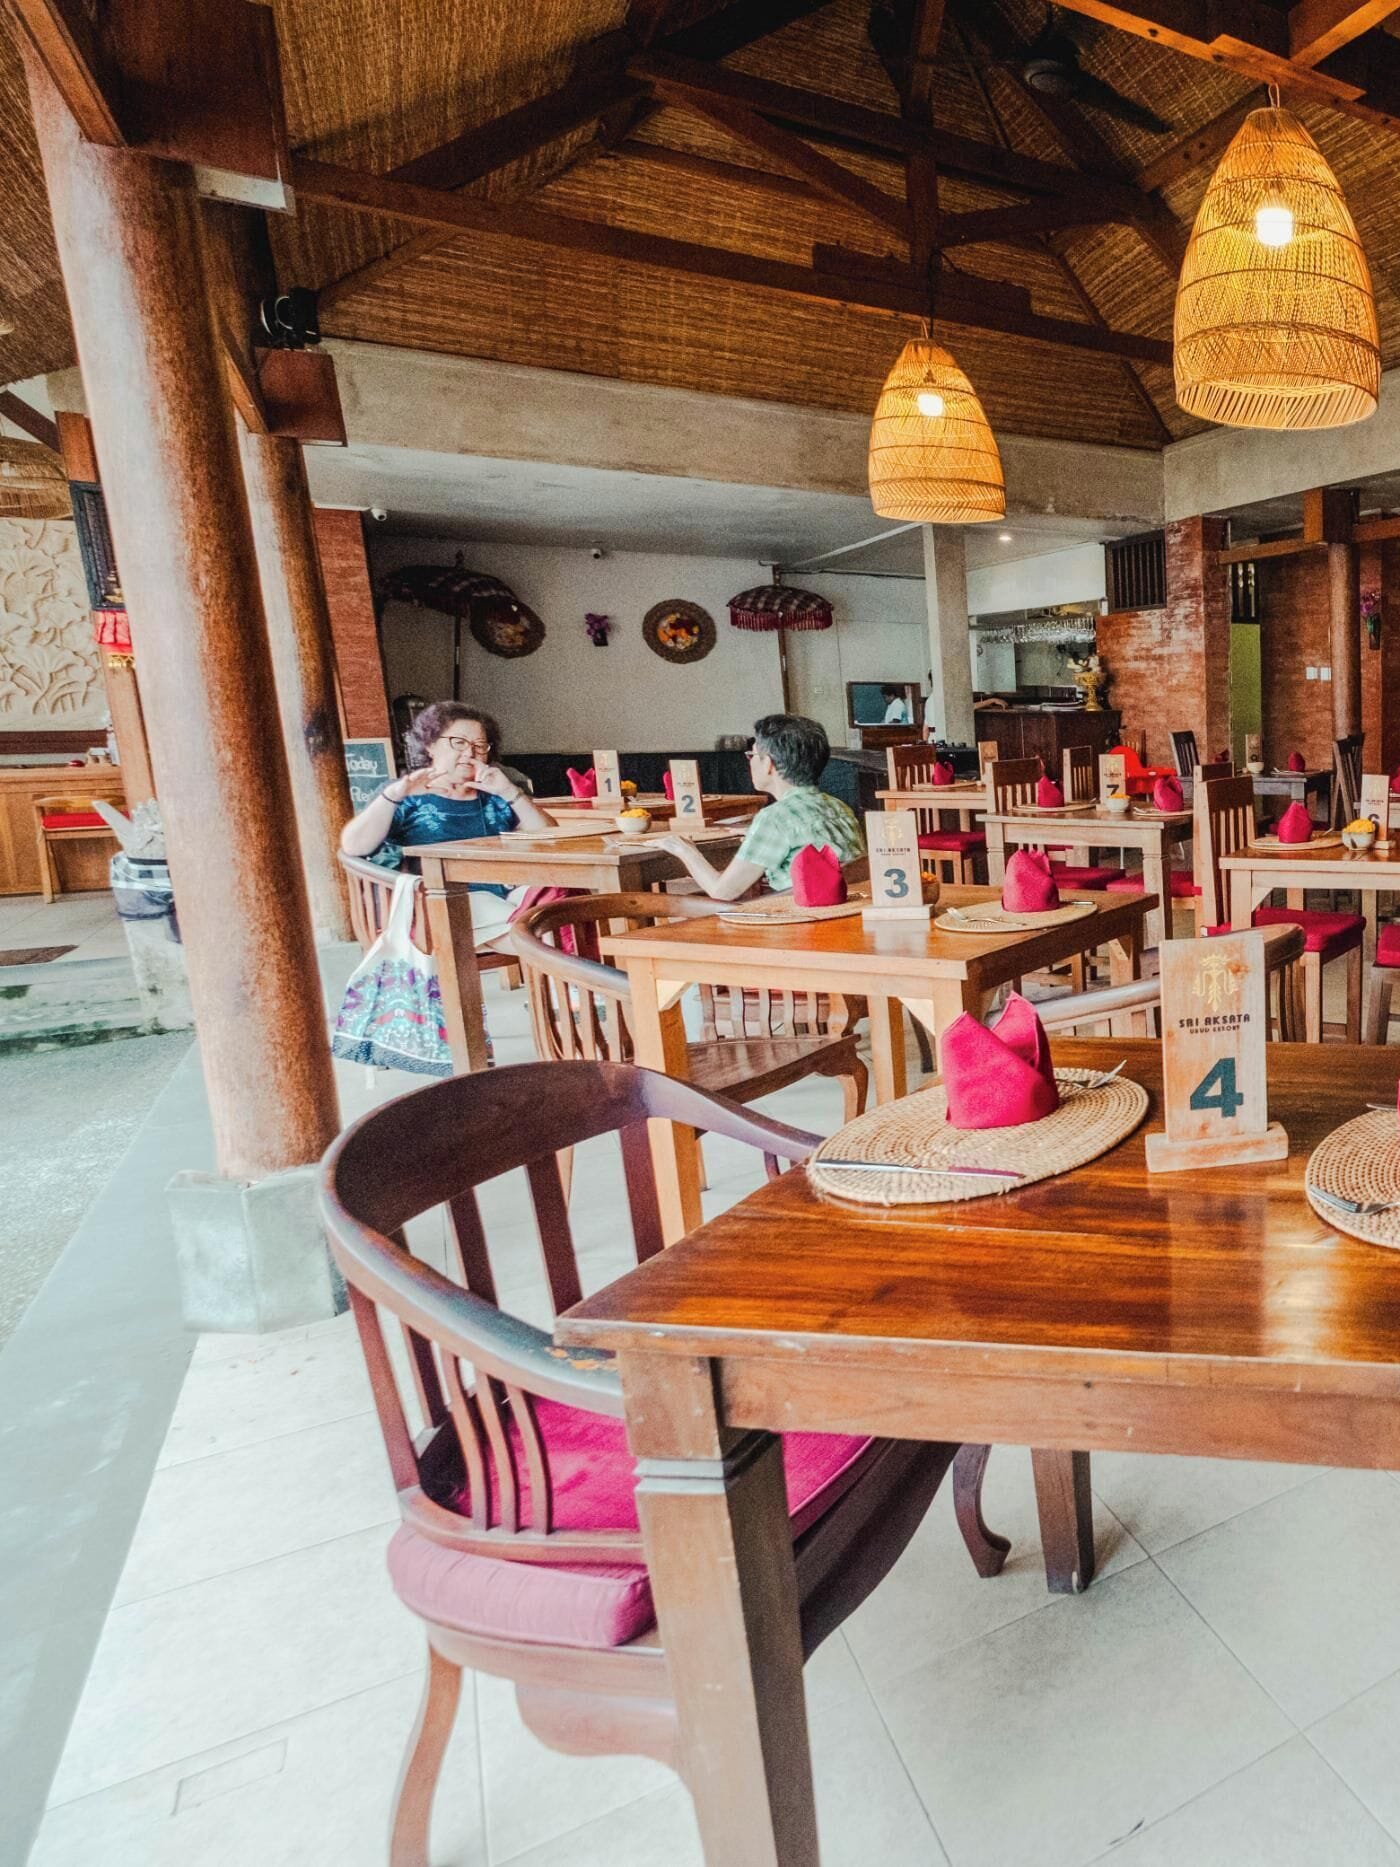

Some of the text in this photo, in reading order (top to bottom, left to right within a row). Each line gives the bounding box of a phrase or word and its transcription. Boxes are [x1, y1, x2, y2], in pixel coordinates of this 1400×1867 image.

[604, 778, 612, 792] 1
[681, 794, 696, 813] 2
[883, 868, 909, 898] 3
[1178, 1013, 1251, 1028] SRI AKSATA
[1189, 1056, 1244, 1118] 4
